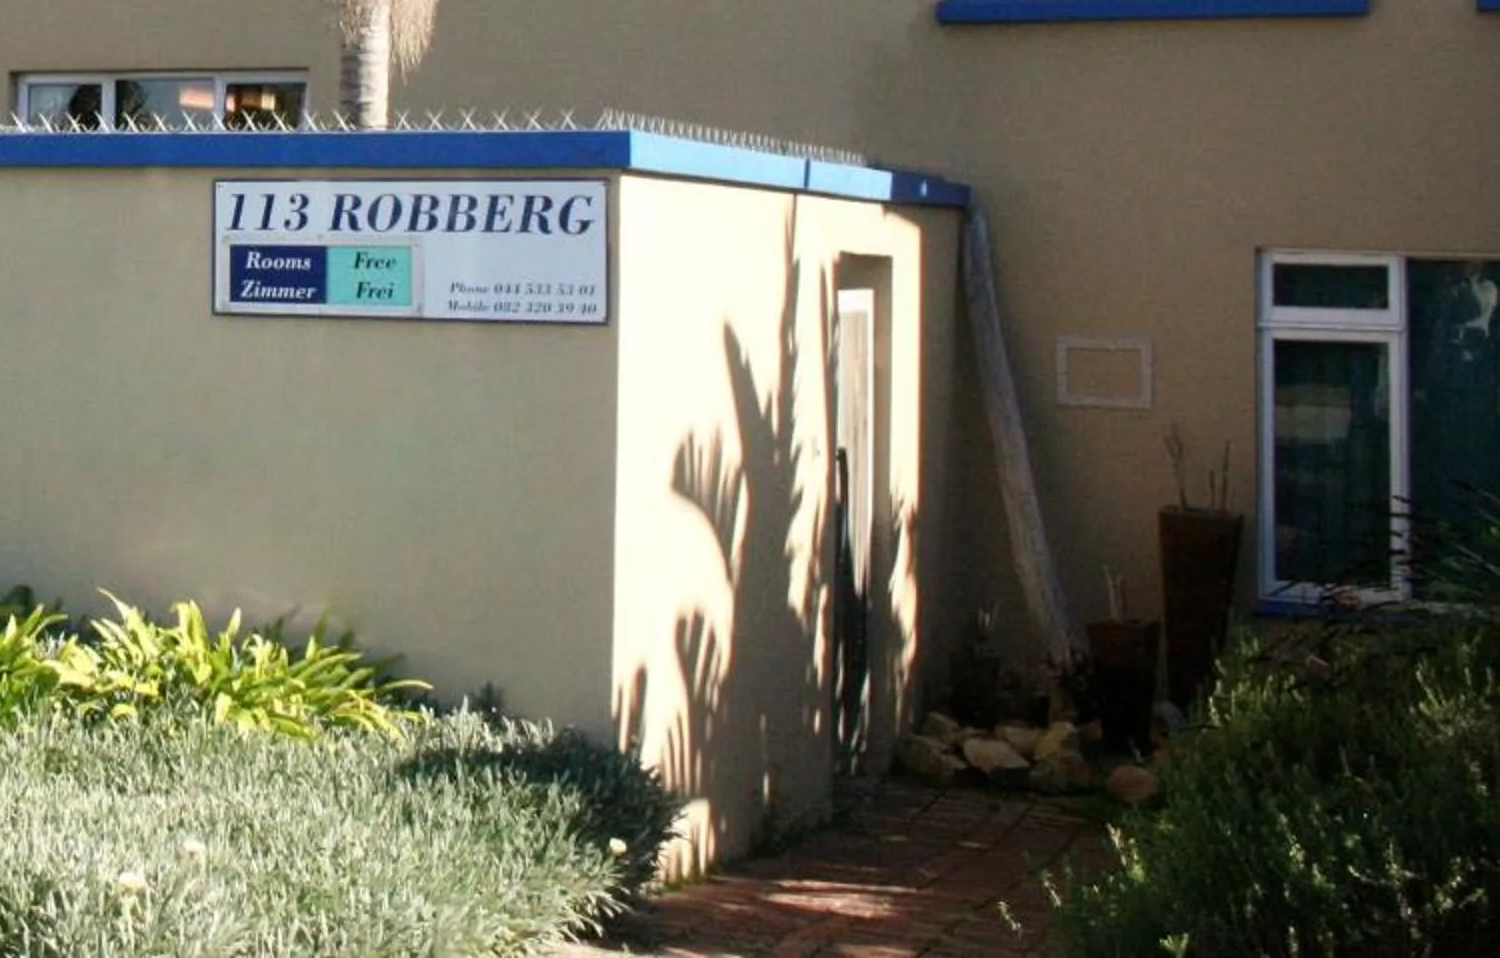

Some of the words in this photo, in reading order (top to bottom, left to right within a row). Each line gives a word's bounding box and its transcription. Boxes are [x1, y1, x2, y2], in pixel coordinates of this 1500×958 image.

[225, 193, 310, 231] 113
[328, 193, 596, 236] ROBBERG
[245, 251, 312, 271] Rooms
[353, 251, 397, 271] Free
[240, 280, 316, 299] Zimmer
[355, 281, 395, 300] Frei
